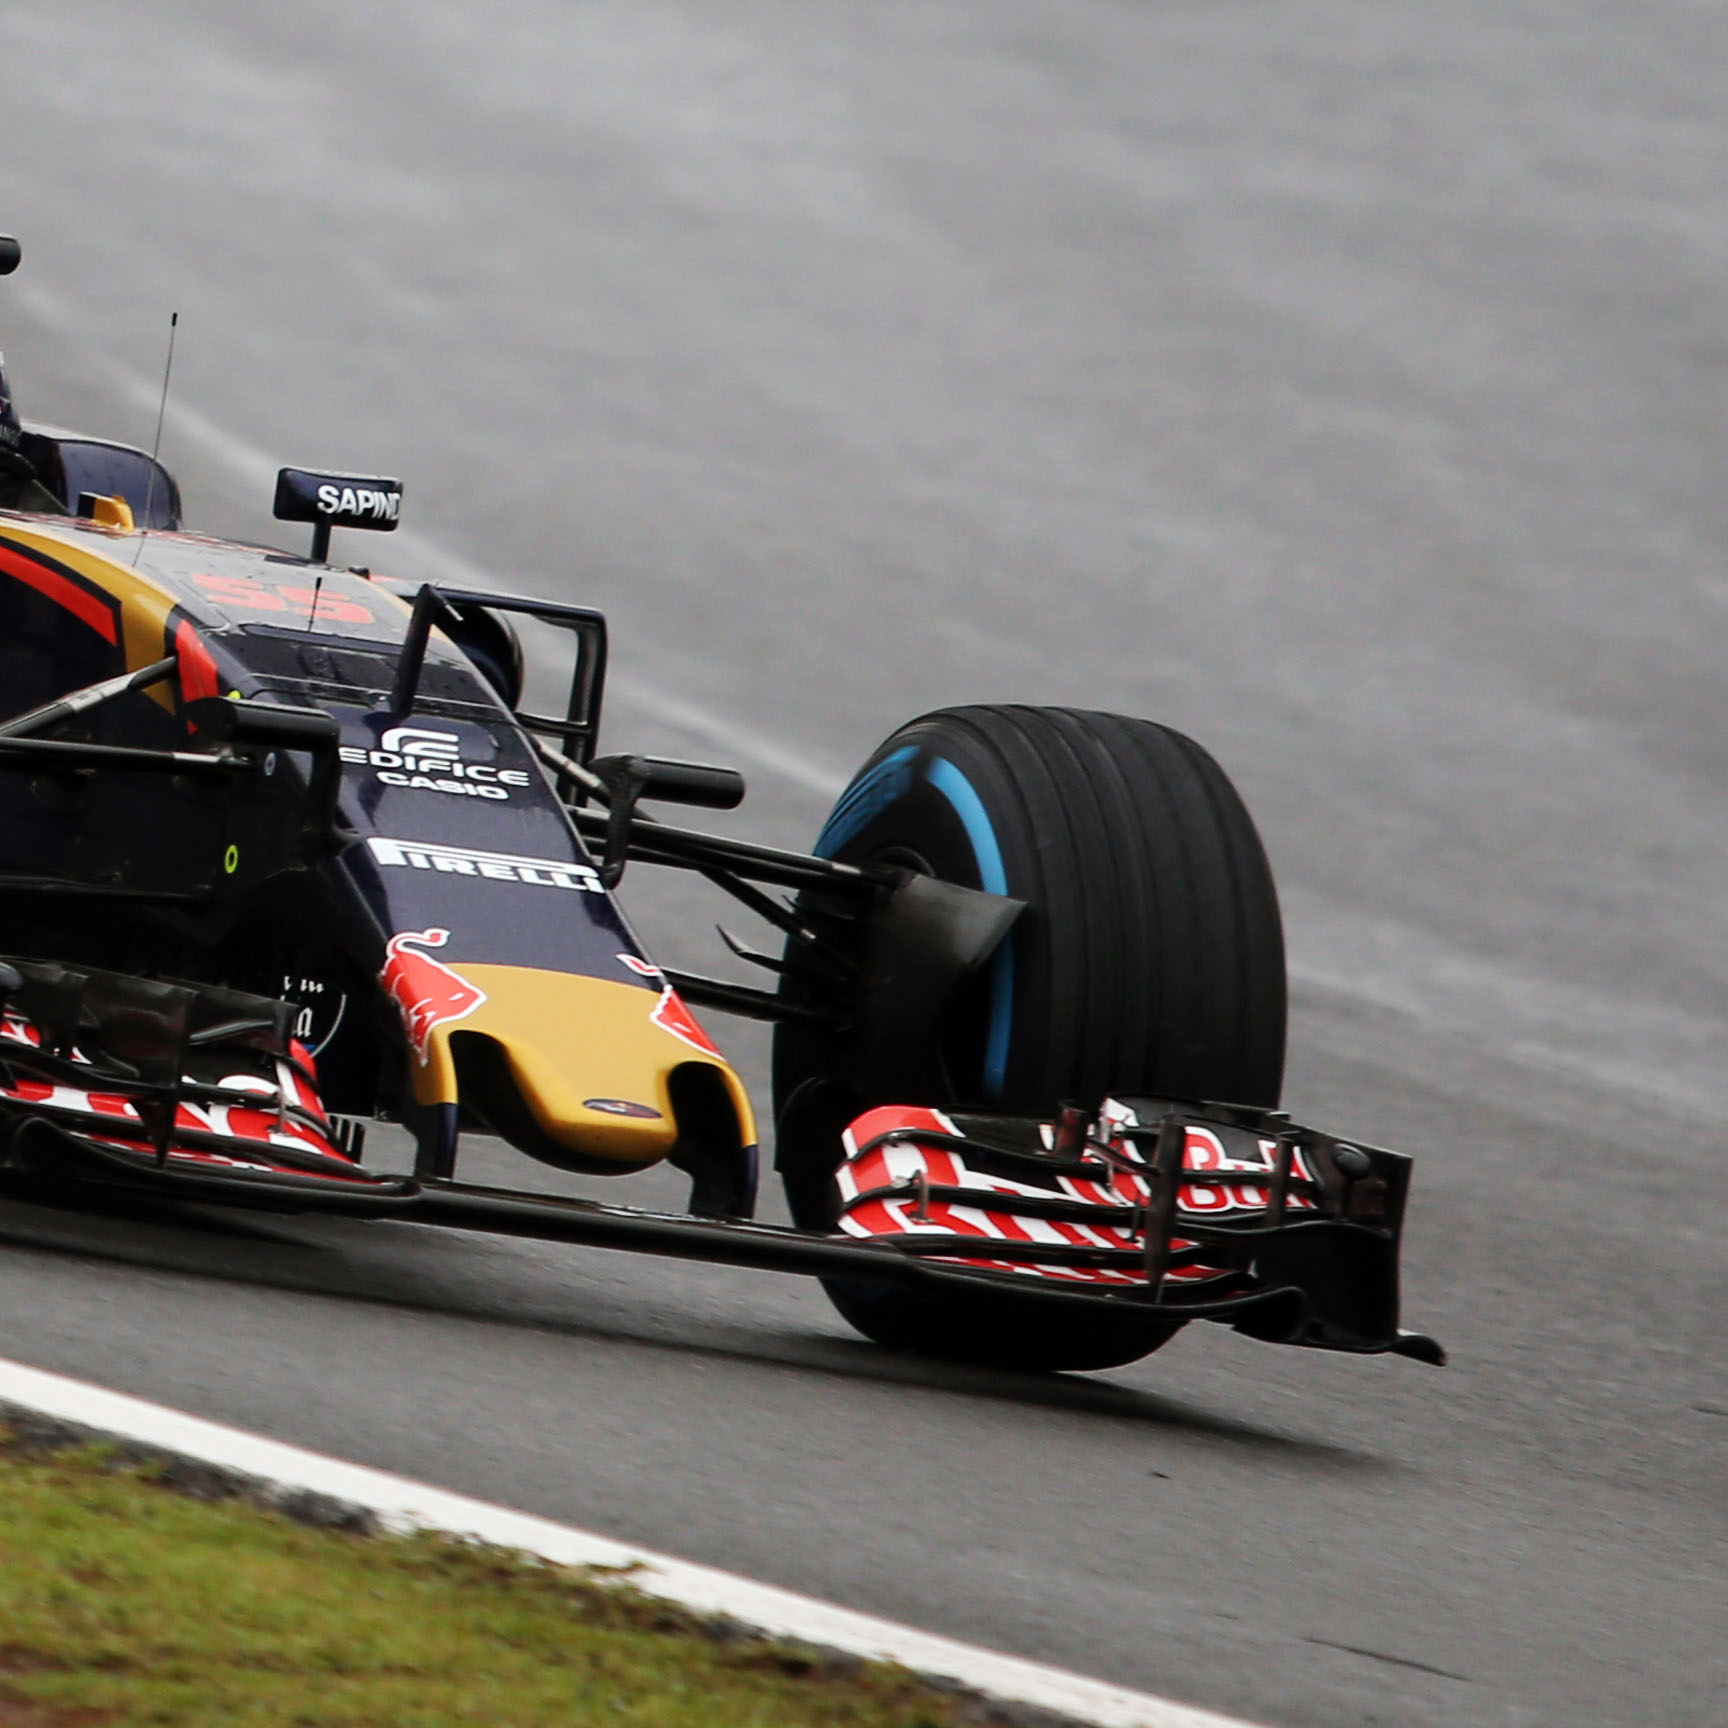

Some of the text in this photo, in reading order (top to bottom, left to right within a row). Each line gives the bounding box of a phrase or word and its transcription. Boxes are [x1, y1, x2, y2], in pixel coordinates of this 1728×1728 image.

[317, 484, 399, 520] SAPIND
[192, 573, 375, 624] 55
[338, 746, 530, 787] EDIFICE
[376, 771, 509, 800] CASIO
[366, 836, 607, 893] PIRELLI
